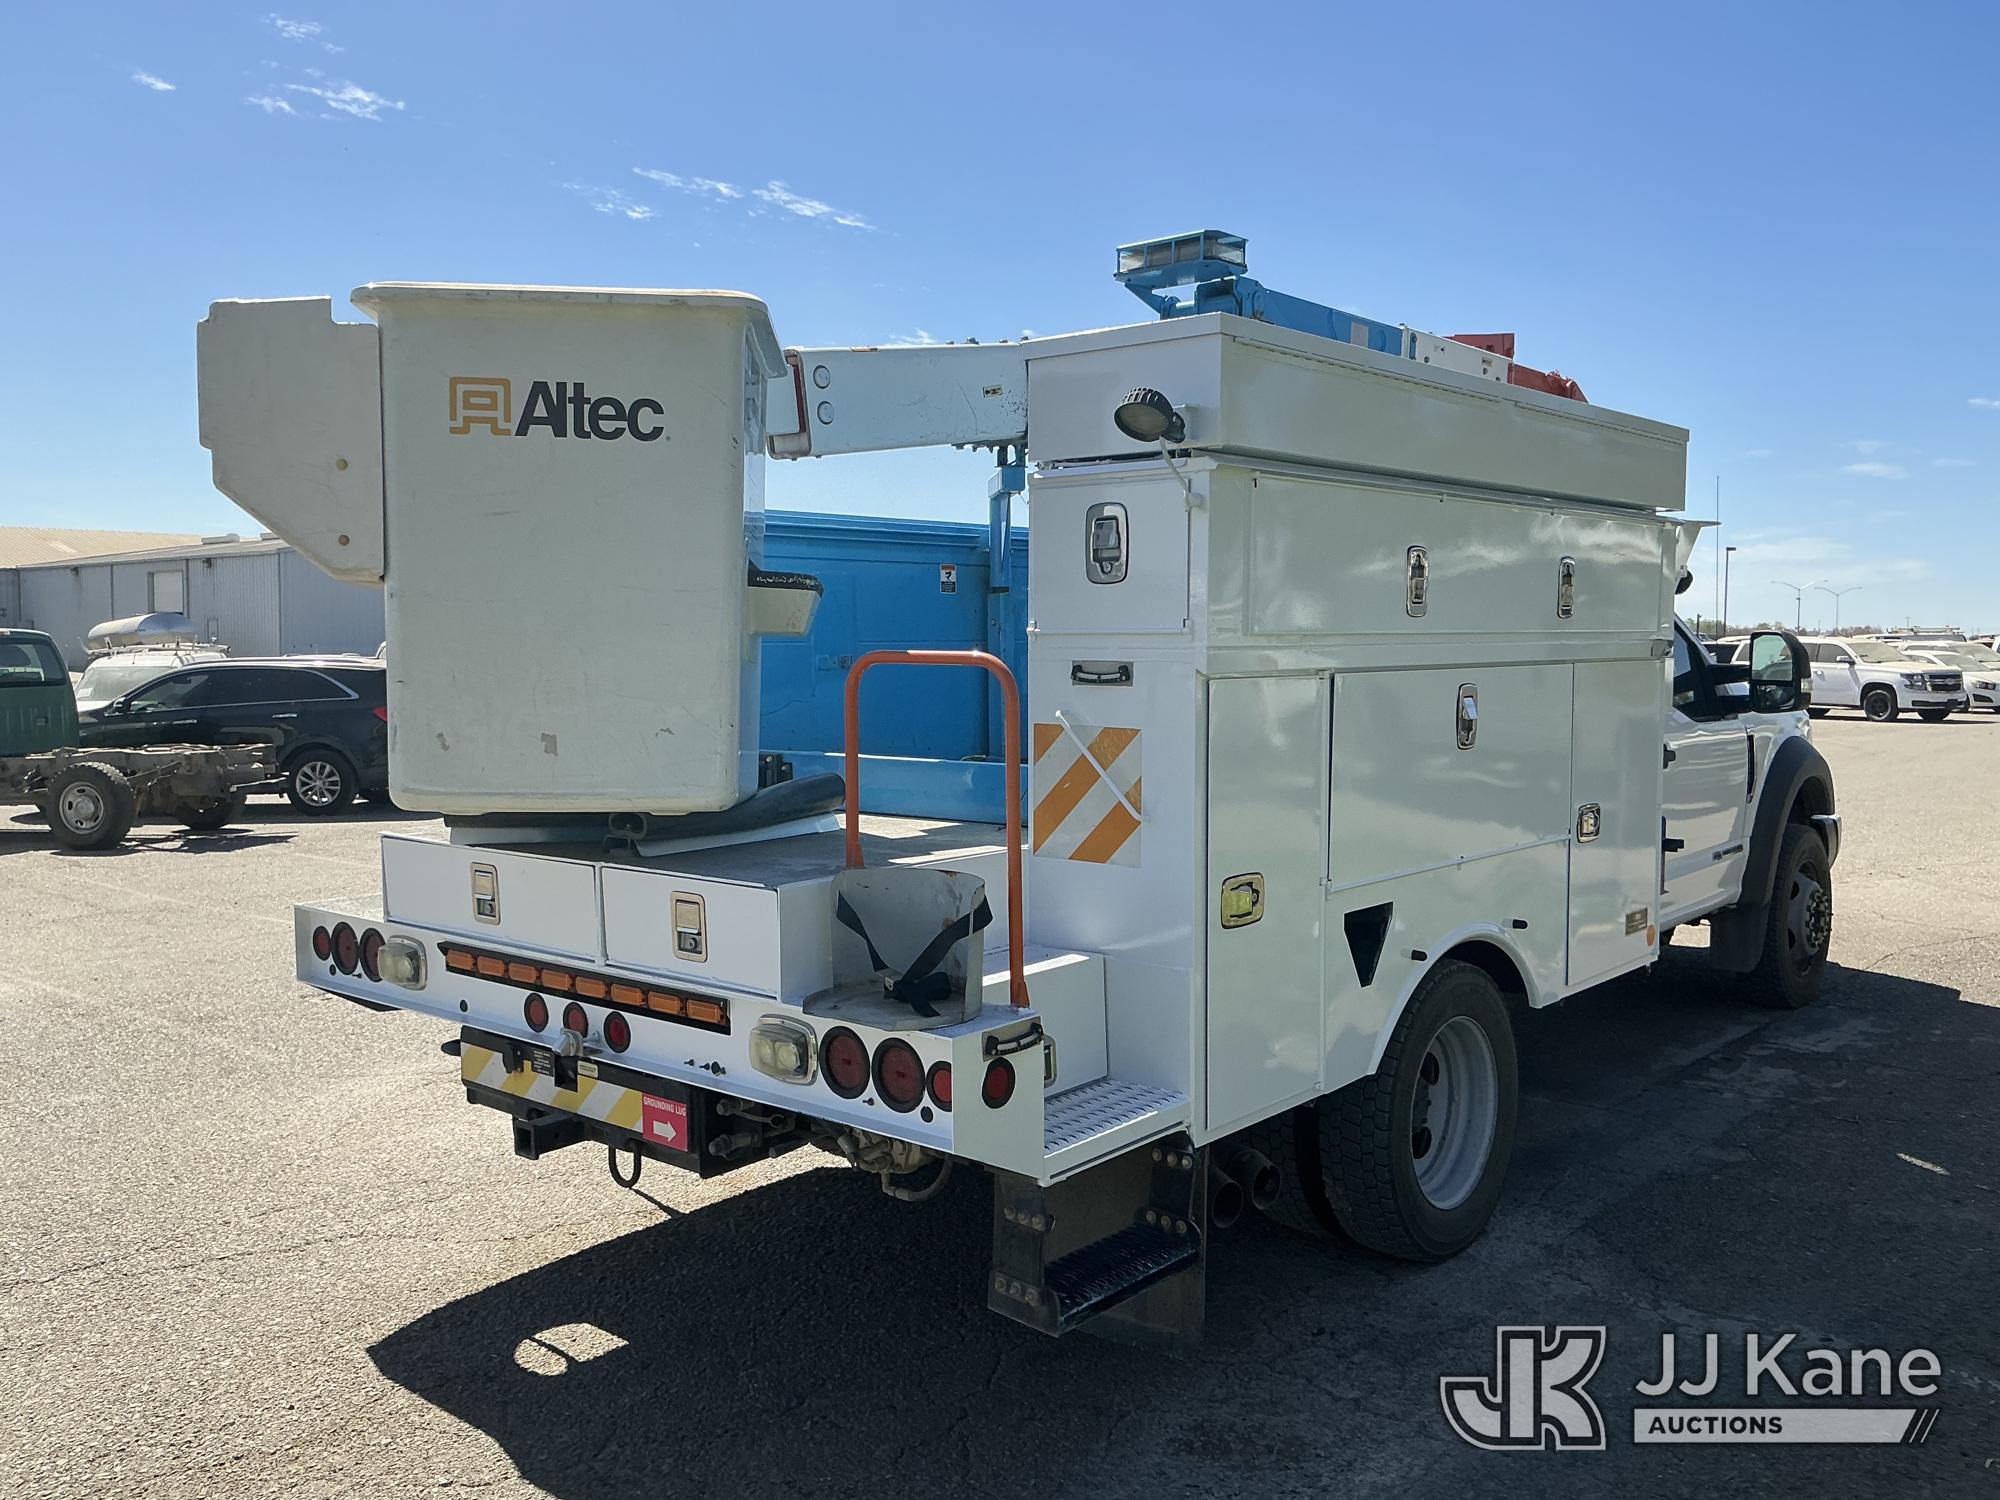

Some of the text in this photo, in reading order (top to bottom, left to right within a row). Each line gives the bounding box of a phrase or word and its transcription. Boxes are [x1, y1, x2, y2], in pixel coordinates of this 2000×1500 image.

[514, 380, 665, 442] Altec
[643, 1096, 687, 1117] GROUNDING LUG
